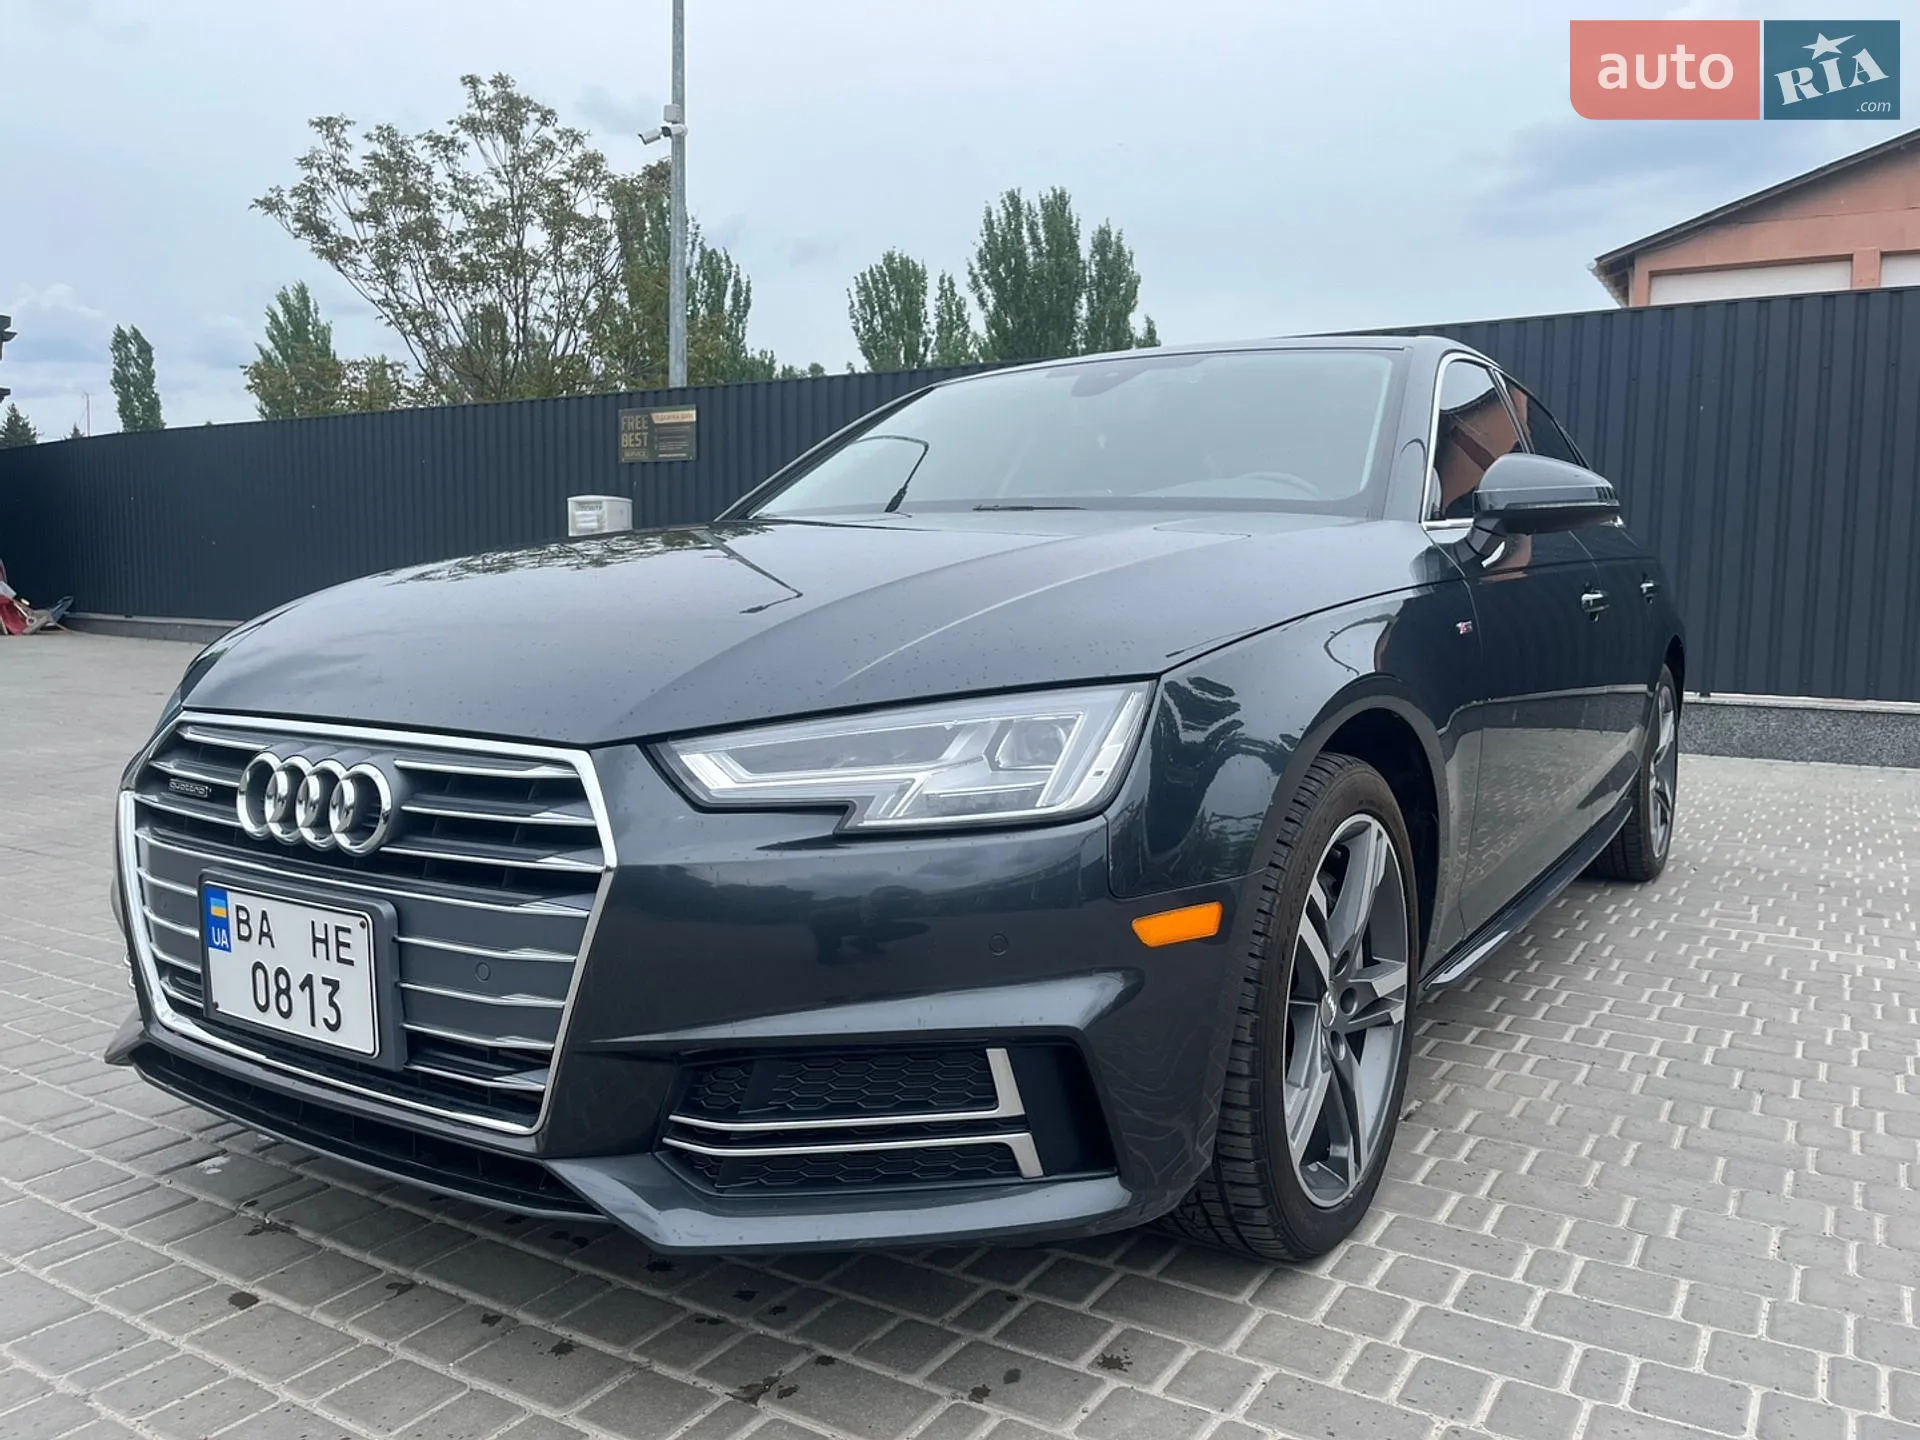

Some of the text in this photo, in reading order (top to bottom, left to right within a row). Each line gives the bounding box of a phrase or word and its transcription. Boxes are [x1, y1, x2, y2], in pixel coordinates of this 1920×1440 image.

[621, 414, 648, 431] FREE
[621, 431, 648, 448] BEST
[211, 926, 230, 949] UA
[235, 904, 355, 967] BA HE
[251, 961, 341, 1032] 0813
